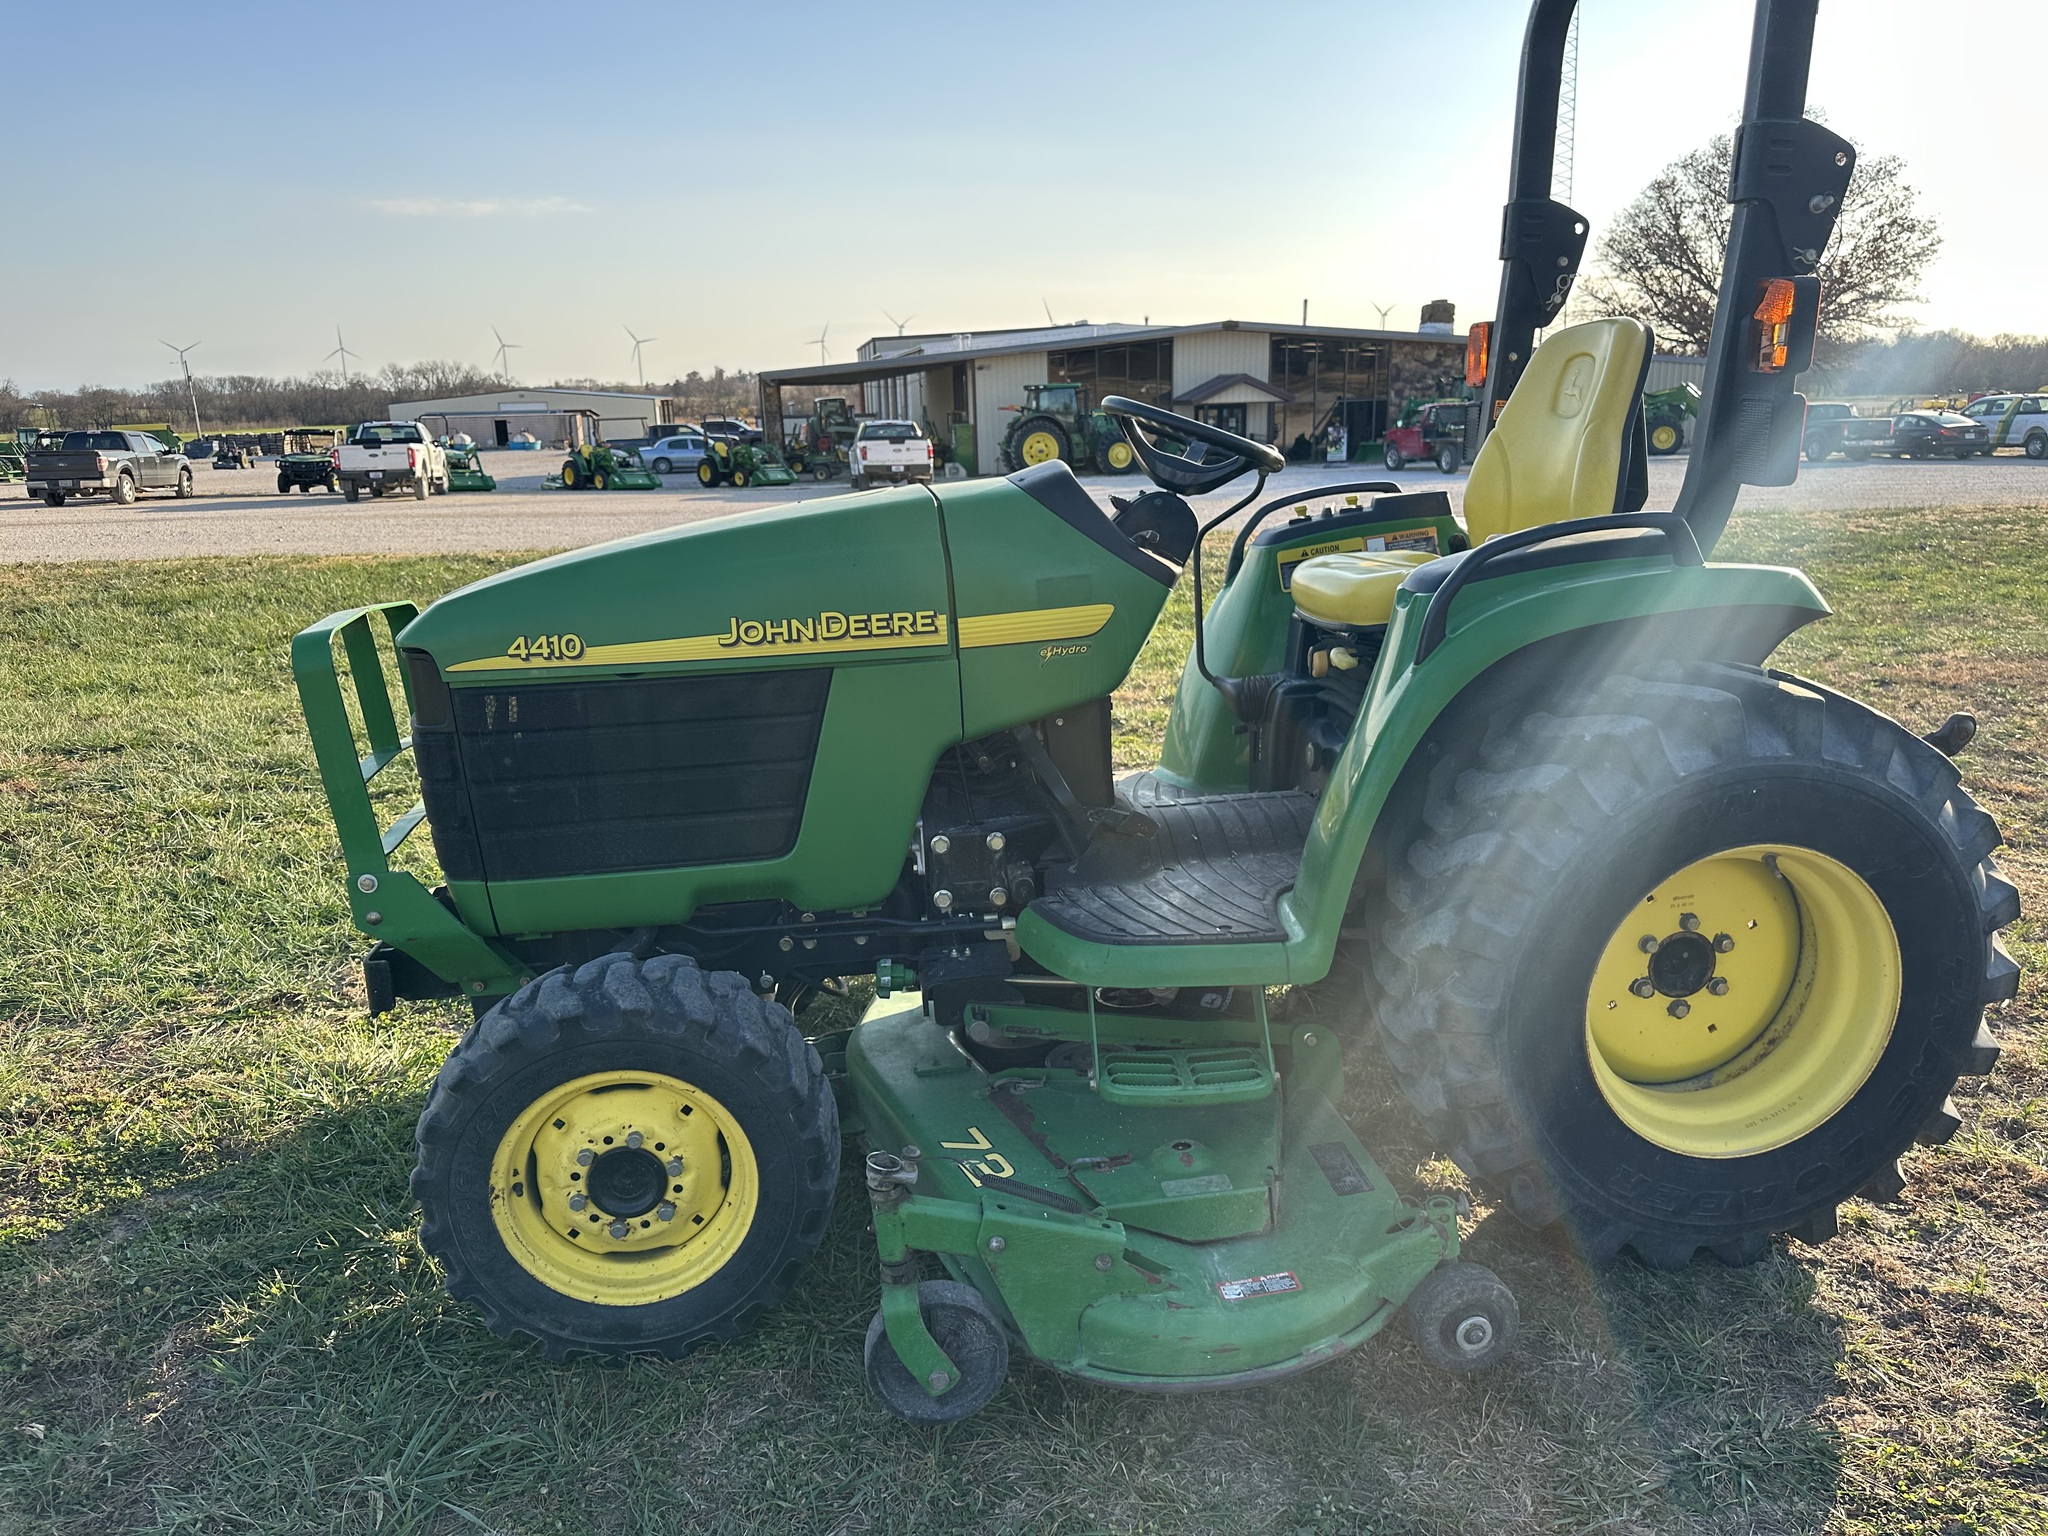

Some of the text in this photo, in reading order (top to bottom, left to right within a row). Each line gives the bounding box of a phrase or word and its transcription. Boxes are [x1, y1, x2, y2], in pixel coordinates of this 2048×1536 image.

[1310, 545, 1340, 556] CAUTION
[1399, 530, 1430, 540] WARNING
[718, 610, 938, 647] JOHN DEERE
[507, 633, 585, 661] 4410
[938, 1126, 1016, 1188] 72
[1608, 1132, 1866, 1217] LOADER
